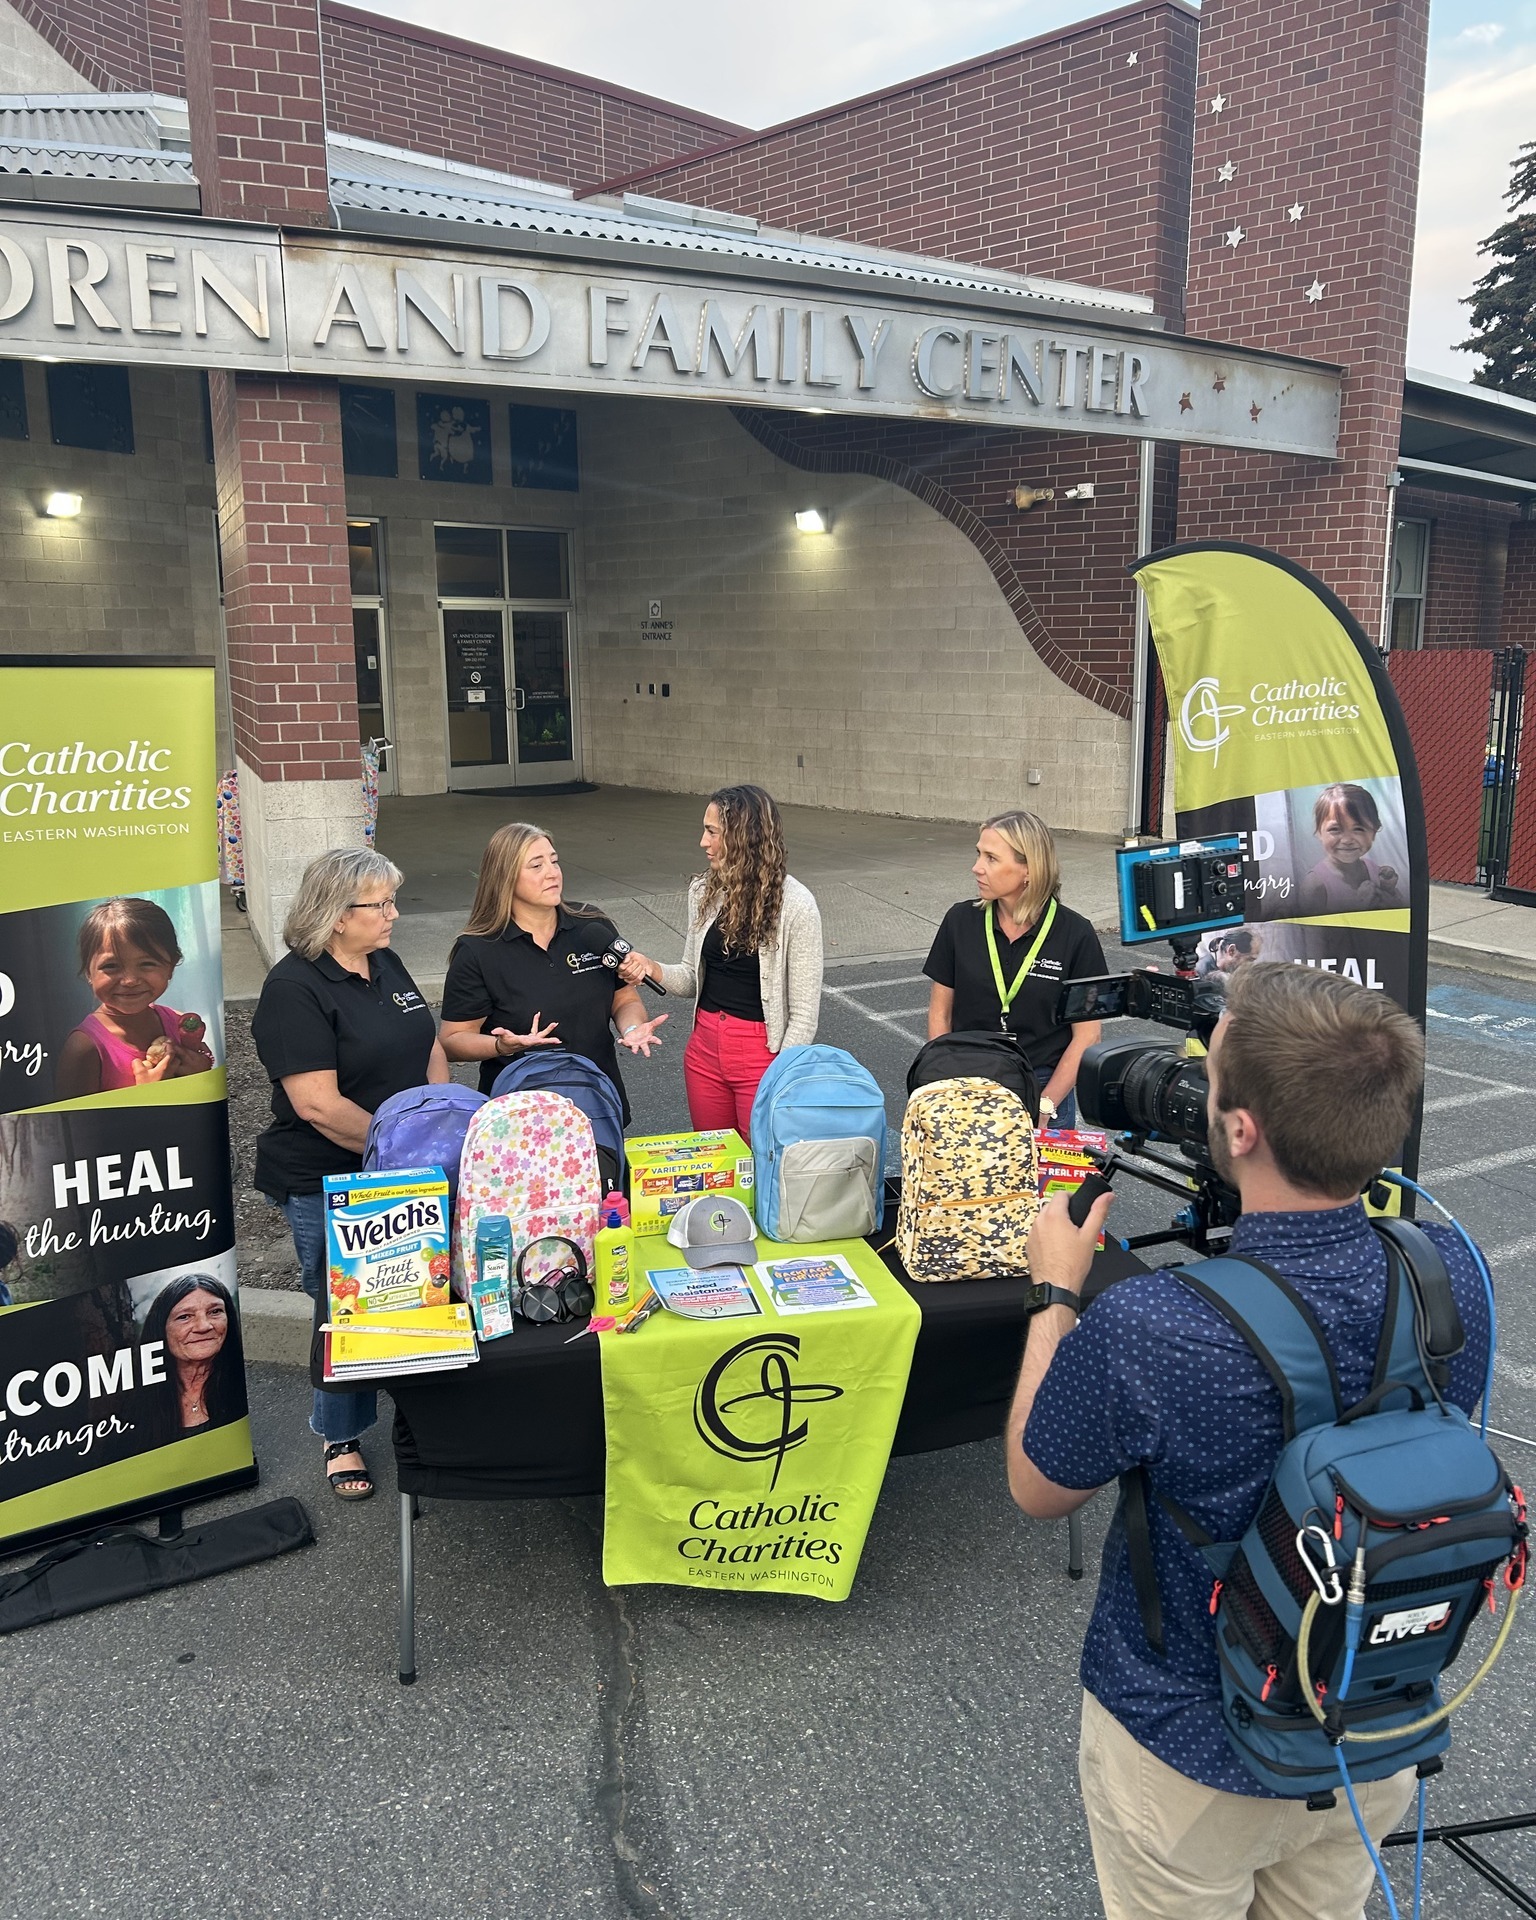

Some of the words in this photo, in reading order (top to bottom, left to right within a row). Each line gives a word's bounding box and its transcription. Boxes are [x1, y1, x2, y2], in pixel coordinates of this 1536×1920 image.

[313, 262, 552, 361] AND
[587, 285, 893, 389] FAMILY
[911, 325, 1152, 418] CENTER
[651, 621, 673, 629] ANNE'S
[642, 632, 672, 640] ENTRANCE
[1250, 676, 1348, 704] Catholic
[1252, 700, 1360, 727] Charities
[1254, 731, 1296, 742] EASTERN
[1298, 726, 1360, 738] WASHINGTON
[0, 740, 172, 777] Catholic
[0, 779, 192, 817] Charities
[3, 828, 77, 843] EASTERN
[83, 823, 190, 838] WASHINGTON
[0, 1040, 49, 1077] ry.
[636, 1139, 688, 1148] VARIETY
[692, 1135, 724, 1143] PACK
[1064, 1150, 1082, 1158] EARN
[52, 1146, 193, 1209] HEAL
[651, 1165, 688, 1175] VARIETY
[690, 1162, 713, 1171] PACK
[1048, 1168, 1072, 1177] REAL
[332, 1194, 346, 1203] 90
[350, 1190, 372, 1200] Whole
[373, 1190, 391, 1198] Fruit
[24, 1220, 83, 1258] the
[88, 1203, 217, 1249] hurting.
[337, 1201, 440, 1252] Welch's
[370, 1249, 396, 1261] MIXED
[396, 1243, 419, 1254] FRUIT
[376, 1258, 414, 1279] Fruit
[365, 1270, 420, 1293] Snacks
[670, 1285, 738, 1296] Assistance?
[687, 1282, 717, 1290] Need
[0, 1340, 167, 1422] COME
[0, 1414, 135, 1465] tranger.
[688, 1494, 839, 1530] Catholic
[677, 1531, 843, 1564] Charities
[688, 1567, 745, 1581] EASTERN
[750, 1569, 834, 1587] WASHINGTON
